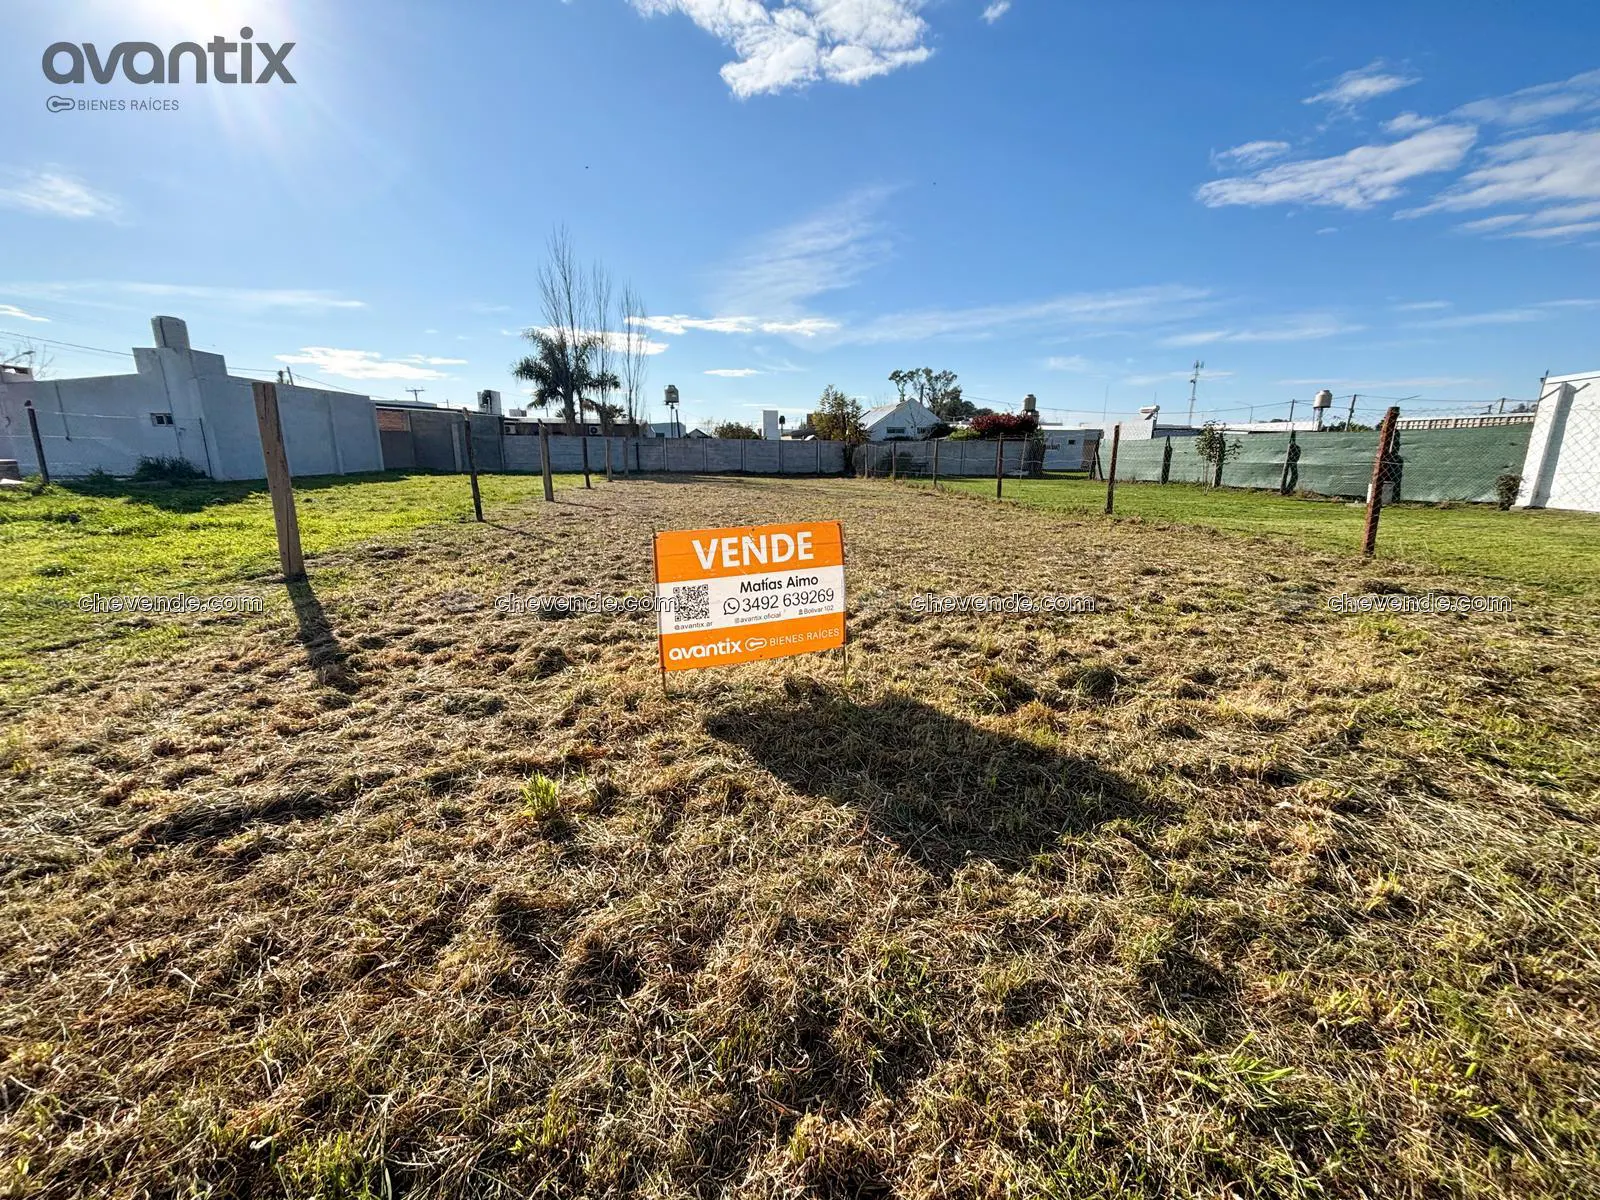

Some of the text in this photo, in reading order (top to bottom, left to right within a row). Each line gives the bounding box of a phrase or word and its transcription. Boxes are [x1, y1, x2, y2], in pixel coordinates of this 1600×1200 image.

[692, 531, 815, 570] VENDE
[740, 574, 819, 594] Matías Aimo
[742, 588, 835, 613] 3492 639269
[669, 637, 743, 661] avantix
[769, 627, 840, 647] BIENES RAÍCES
